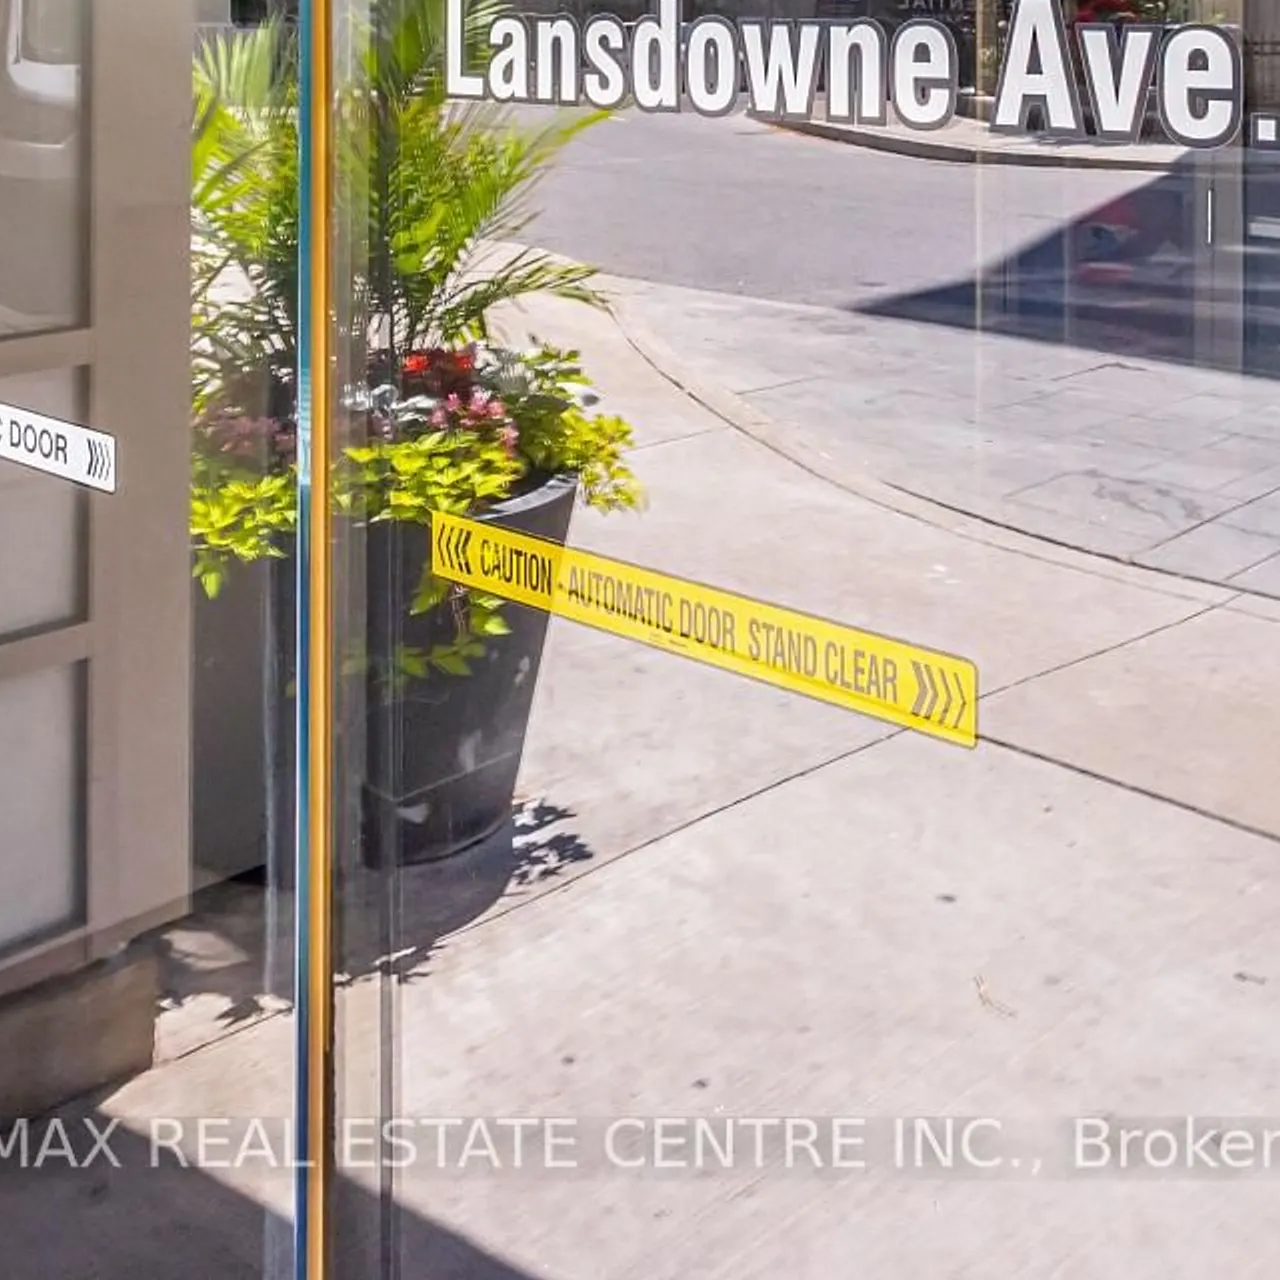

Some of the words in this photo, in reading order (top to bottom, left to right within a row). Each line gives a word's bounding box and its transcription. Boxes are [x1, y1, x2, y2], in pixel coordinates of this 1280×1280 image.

[9, 419, 68, 465] DOOR
[479, 538, 552, 595] CAUTION
[567, 565, 674, 635] AUTOMATIC
[679, 602, 736, 654] DOOR
[748, 620, 817, 678] STAND
[824, 640, 898, 704] CLEAR
